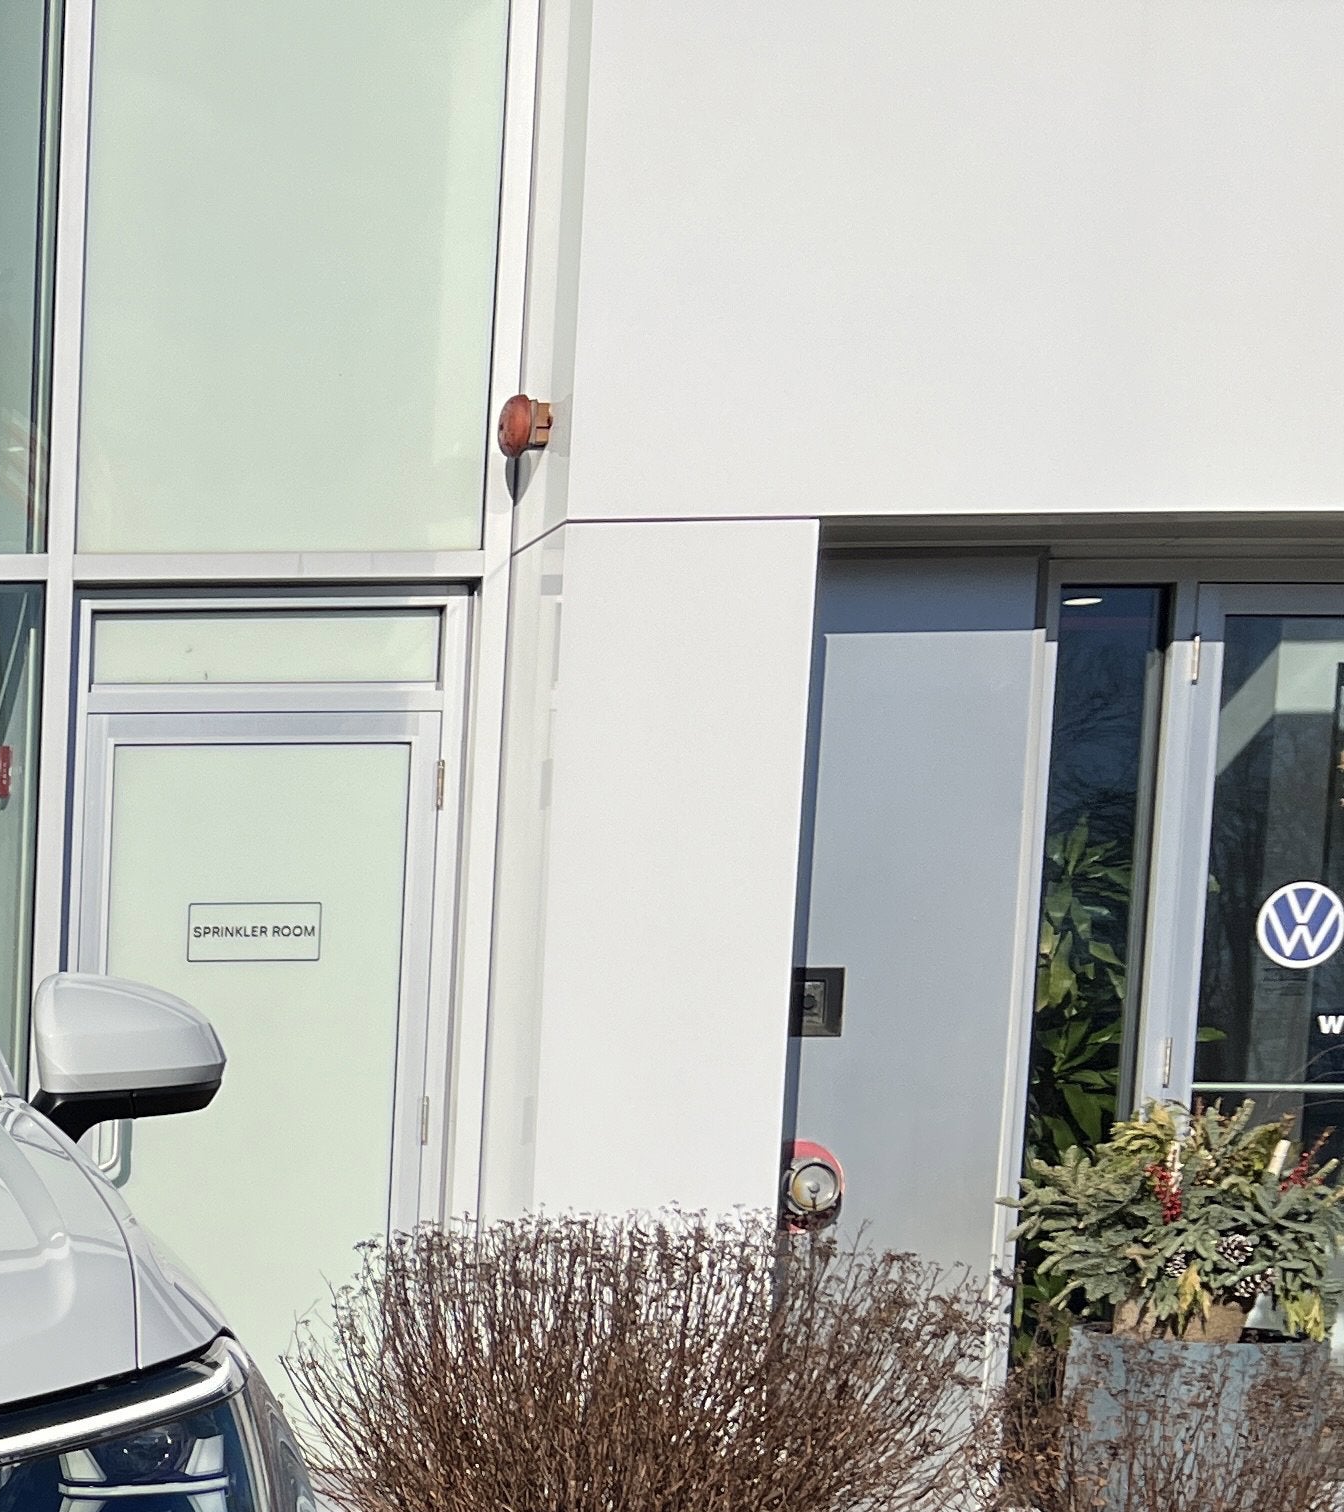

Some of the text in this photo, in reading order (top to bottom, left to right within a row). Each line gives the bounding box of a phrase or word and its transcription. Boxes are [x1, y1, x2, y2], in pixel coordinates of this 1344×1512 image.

[193, 925, 316, 938] SPRINKLER ROOM
[1262, 885, 1342, 963] VW
